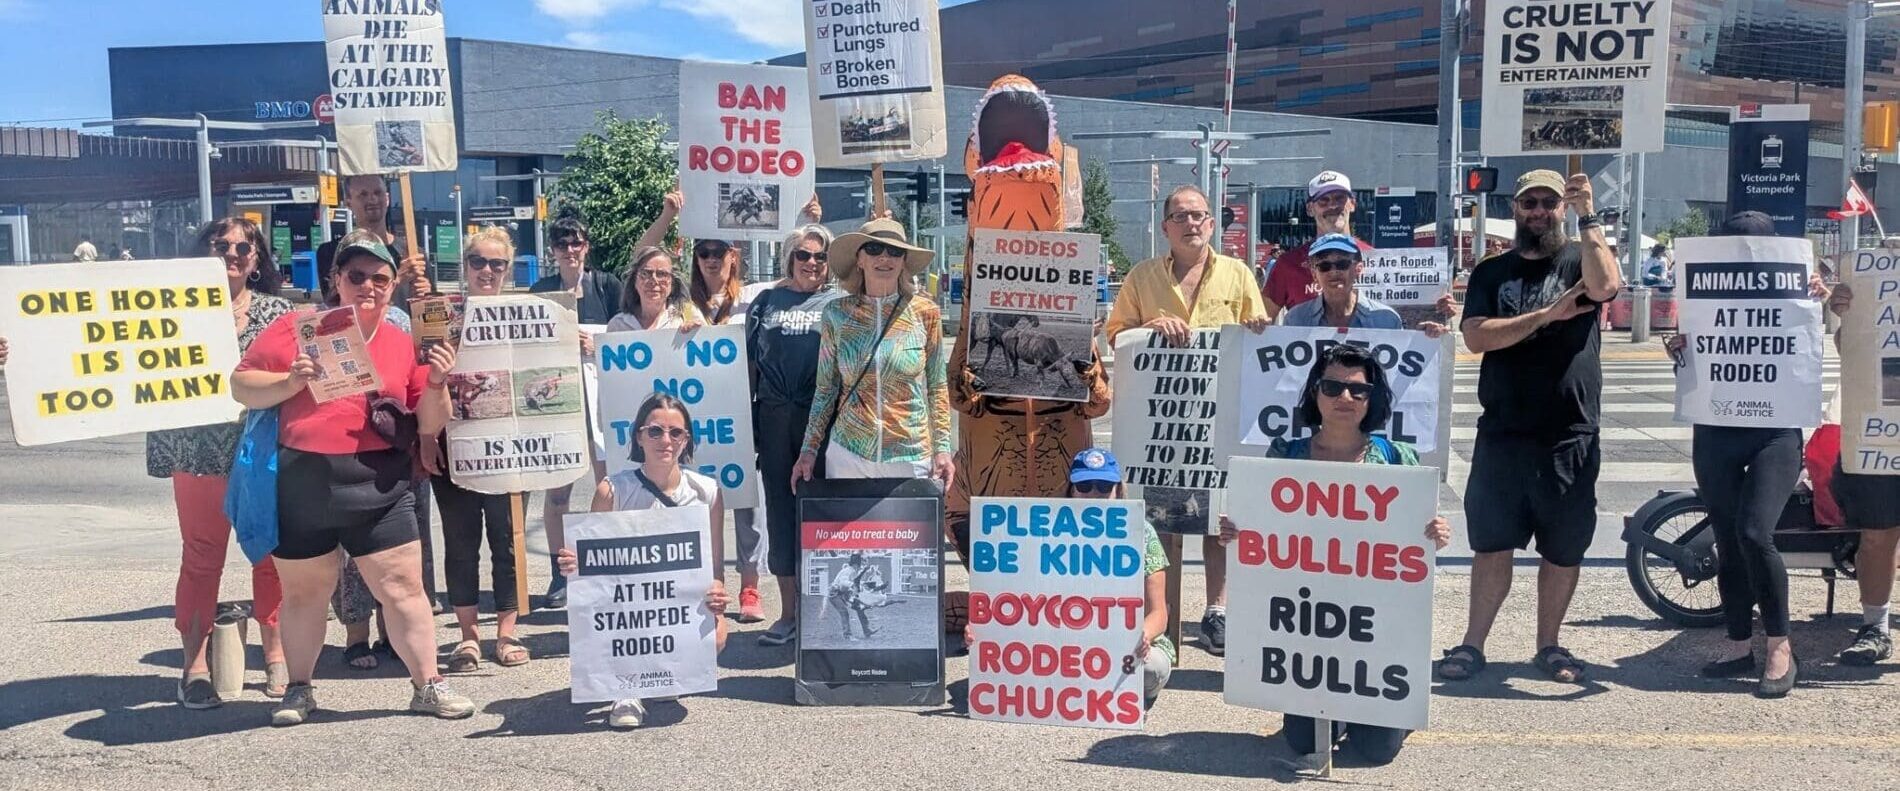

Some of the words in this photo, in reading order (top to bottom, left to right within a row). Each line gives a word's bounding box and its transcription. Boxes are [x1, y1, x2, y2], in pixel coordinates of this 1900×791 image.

[323, 0, 437, 15] ANIMALS
[831, 1, 881, 17] Death
[1502, 1, 1654, 29] CRUELTY
[364, 20, 408, 39] DIE
[832, 17, 920, 38] Punctured
[340, 44, 374, 63] AT
[383, 44, 433, 63] THE
[834, 37, 886, 53] Lungs
[1501, 33, 1541, 64] IS
[1556, 29, 1654, 62] NOT
[835, 58, 896, 74] Broken
[1500, 66, 1651, 82] ENTERTAINMENT
[331, 67, 446, 88] CALGARY
[837, 73, 890, 89] Bones
[334, 91, 446, 109] STAMPEDE
[718, 82, 786, 112] BAN
[255, 101, 310, 118] BMO
[720, 116, 781, 144] THE
[688, 145, 805, 177] RODEO
[1741, 173, 1778, 182] Victoria
[1779, 173, 1800, 182] Park
[1746, 185, 1795, 195] Stampede
[995, 238, 1078, 258] RODEOS
[1379, 257, 1397, 267] Are
[1400, 255, 1437, 269] Roped,
[976, 263, 1060, 283] SHOULD
[1068, 269, 1093, 286] BE
[1383, 273, 1391, 283] &
[1394, 271, 1440, 283] Terrified
[1692, 272, 1769, 291] ANIMALS
[1775, 272, 1802, 290] DIE
[1365, 289, 1382, 300] the
[1385, 289, 1419, 300] Rodeo
[1879, 281, 1900, 300] P
[21, 291, 94, 315] ONE
[111, 287, 222, 310] HORSE
[989, 291, 1078, 311] EXTINCT
[472, 304, 550, 323] ANIMAL
[1714, 308, 1738, 327] AT
[1745, 308, 1782, 327] THE
[86, 318, 178, 343] DEAD
[465, 322, 557, 342] CRUELTY
[780, 322, 812, 335] SHIT
[601, 341, 652, 372] NO
[686, 338, 738, 367] NO
[1696, 335, 1796, 355] STAMPEDE
[81, 350, 119, 374] IS
[138, 345, 205, 370] ONE
[1710, 363, 1777, 382] RODEO
[41, 388, 114, 414] TOO
[135, 373, 222, 403] MANY
[653, 378, 704, 404] NO
[1154, 376, 1213, 396] HOW
[1147, 398, 1217, 420] YOU'D
[1735, 408, 1774, 417] JUSTICE
[1736, 400, 1774, 409] ANIMAL
[610, 420, 634, 446] T
[692, 418, 736, 445] HE
[1151, 421, 1211, 442] LIKE
[484, 440, 505, 456] IS
[511, 437, 552, 453] NOT
[1145, 444, 1175, 464] TO
[1182, 446, 1215, 466] BE
[455, 452, 583, 472] ENTERTAINMENT
[1271, 478, 1399, 521] ONLY
[982, 504, 1128, 538] PLEASE
[815, 529, 829, 540] No
[830, 530, 850, 542] way
[851, 529, 861, 540] to
[863, 529, 886, 540] treat
[887, 530, 894, 540] a
[895, 528, 919, 542] baby
[585, 544, 661, 567] ANIMALS
[666, 541, 695, 562] DIE
[973, 541, 1018, 574] BE
[1040, 543, 1141, 577] KIND
[1238, 530, 1429, 582] BULLIES
[613, 583, 635, 603] AT
[641, 580, 676, 601] THE
[594, 605, 691, 632] STAMPEDE
[968, 592, 1144, 630] BOYCOTT
[612, 634, 675, 657] RODEO
[979, 641, 1111, 679] RODEO
[1122, 654, 1136, 674] &
[639, 678, 675, 688] JUSTICE
[640, 671, 674, 680] ANIMAL
[851, 669, 871, 677] Boycott
[1261, 647, 1410, 701] BULLS
[971, 682, 1141, 724] CHUCKS
